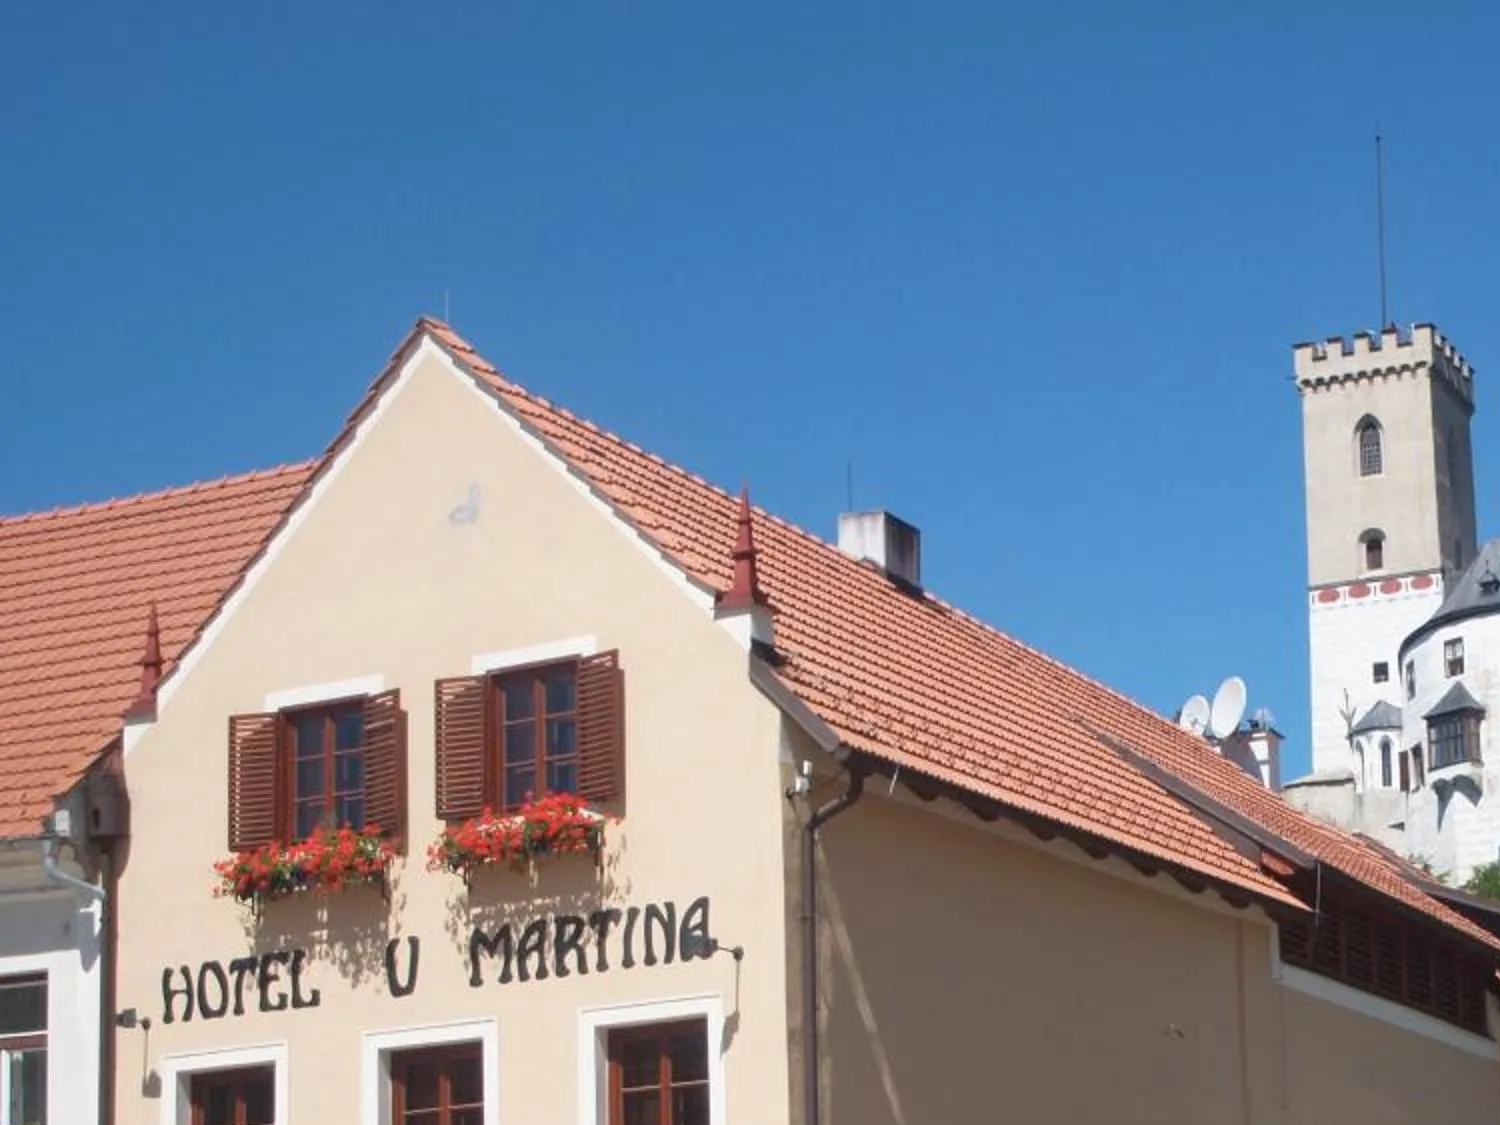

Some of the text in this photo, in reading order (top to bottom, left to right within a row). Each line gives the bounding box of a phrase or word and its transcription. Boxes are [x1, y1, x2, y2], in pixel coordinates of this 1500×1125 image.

[161, 897, 718, 1023] HOTEL U MARTINA
